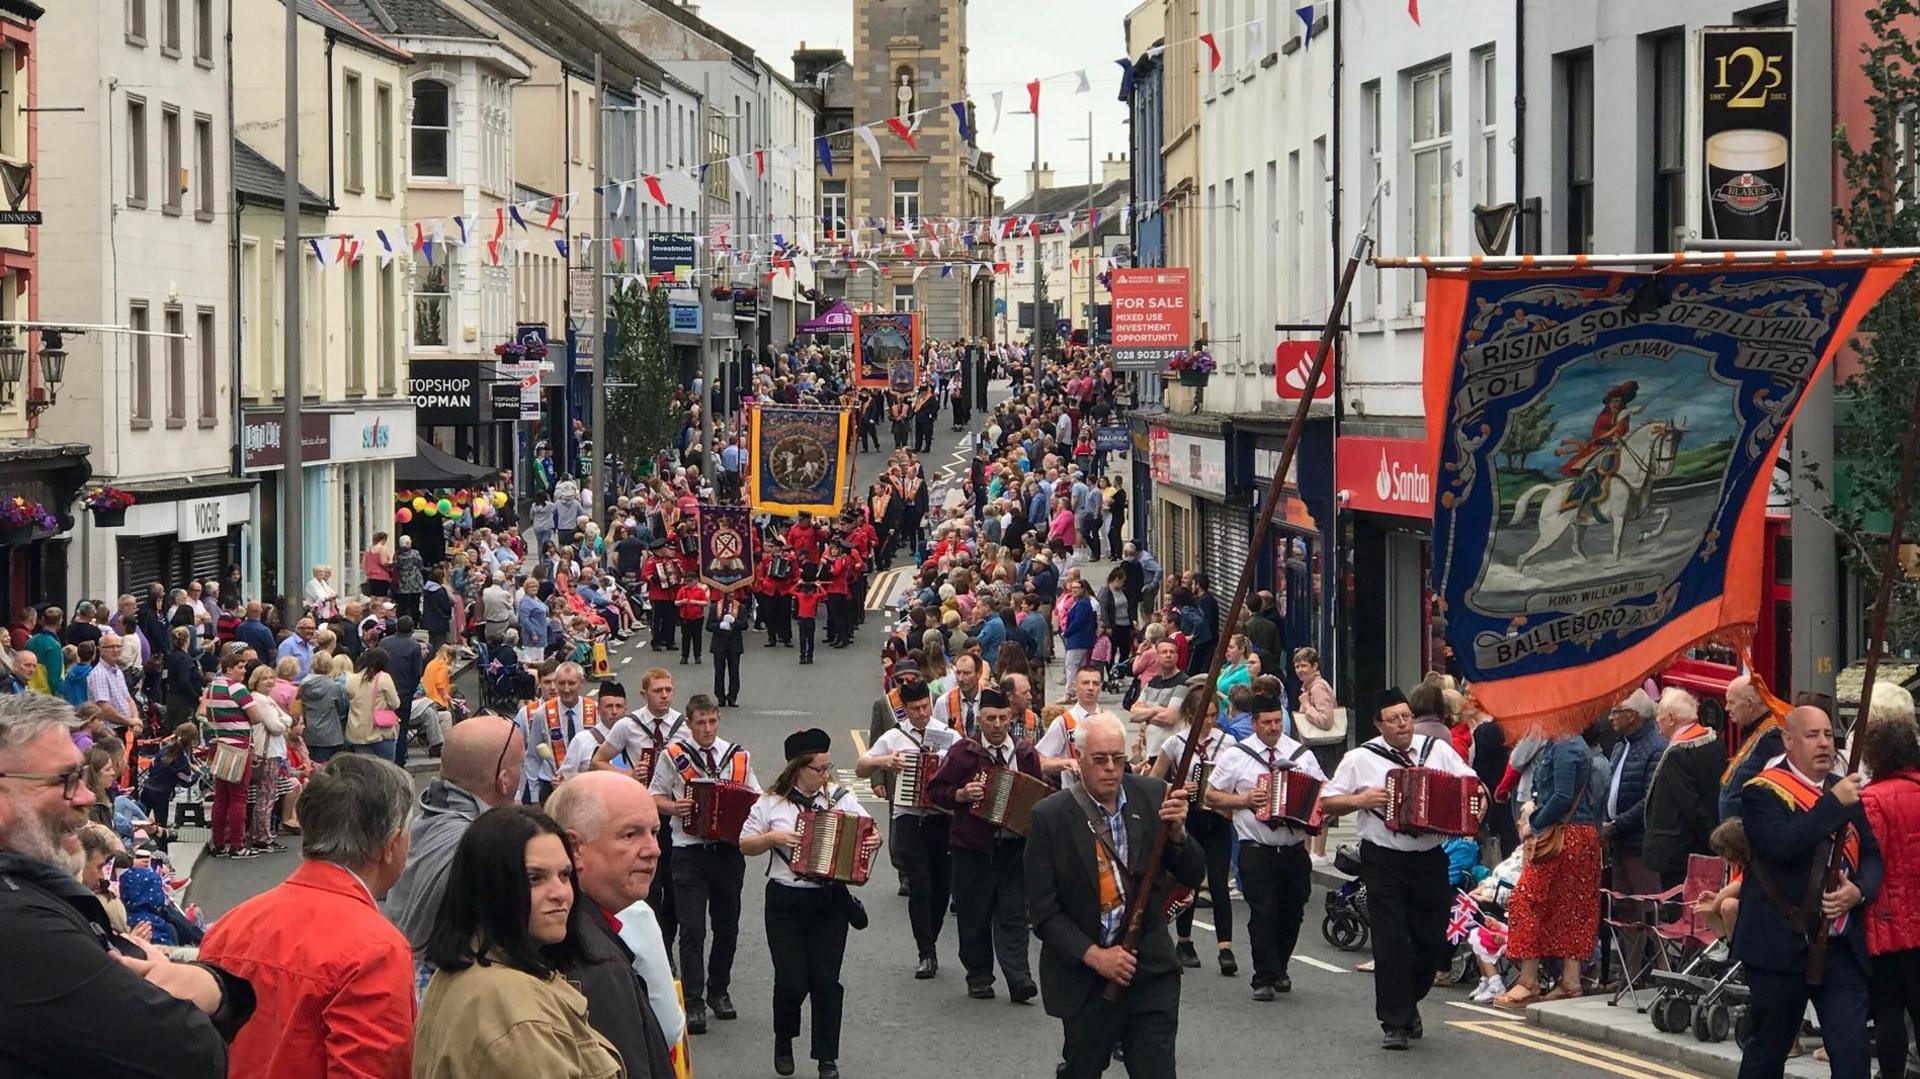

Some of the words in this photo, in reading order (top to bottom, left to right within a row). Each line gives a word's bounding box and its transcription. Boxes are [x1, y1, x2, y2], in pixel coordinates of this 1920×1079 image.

[1714, 47, 1783, 108] 125
[1116, 298, 1145, 309] FOR
[1148, 297, 1184, 308] SALE
[1116, 313, 1144, 321] MIXED
[1145, 313, 1163, 321] USE
[1116, 323, 1172, 332] INVESTMENT
[1116, 333, 1179, 342] OPPORTUNITY
[1483, 326, 1570, 366] RISING
[1668, 304, 1702, 324] OF
[1697, 308, 1819, 342] BILLYHILL
[1116, 350, 1135, 359] 028
[1136, 350, 1161, 359] 9023
[1744, 352, 1809, 374] 1128
[409, 379, 470, 392] TOPSHOP
[408, 395, 470, 408] TOPMAN
[195, 502, 220, 534] VOGUE
[1548, 593, 1577, 607] KING
[1582, 584, 1629, 602] WILLIAM
[1496, 607, 1626, 663] BAILIEBORO
[1817, 657, 1833, 673] 15
